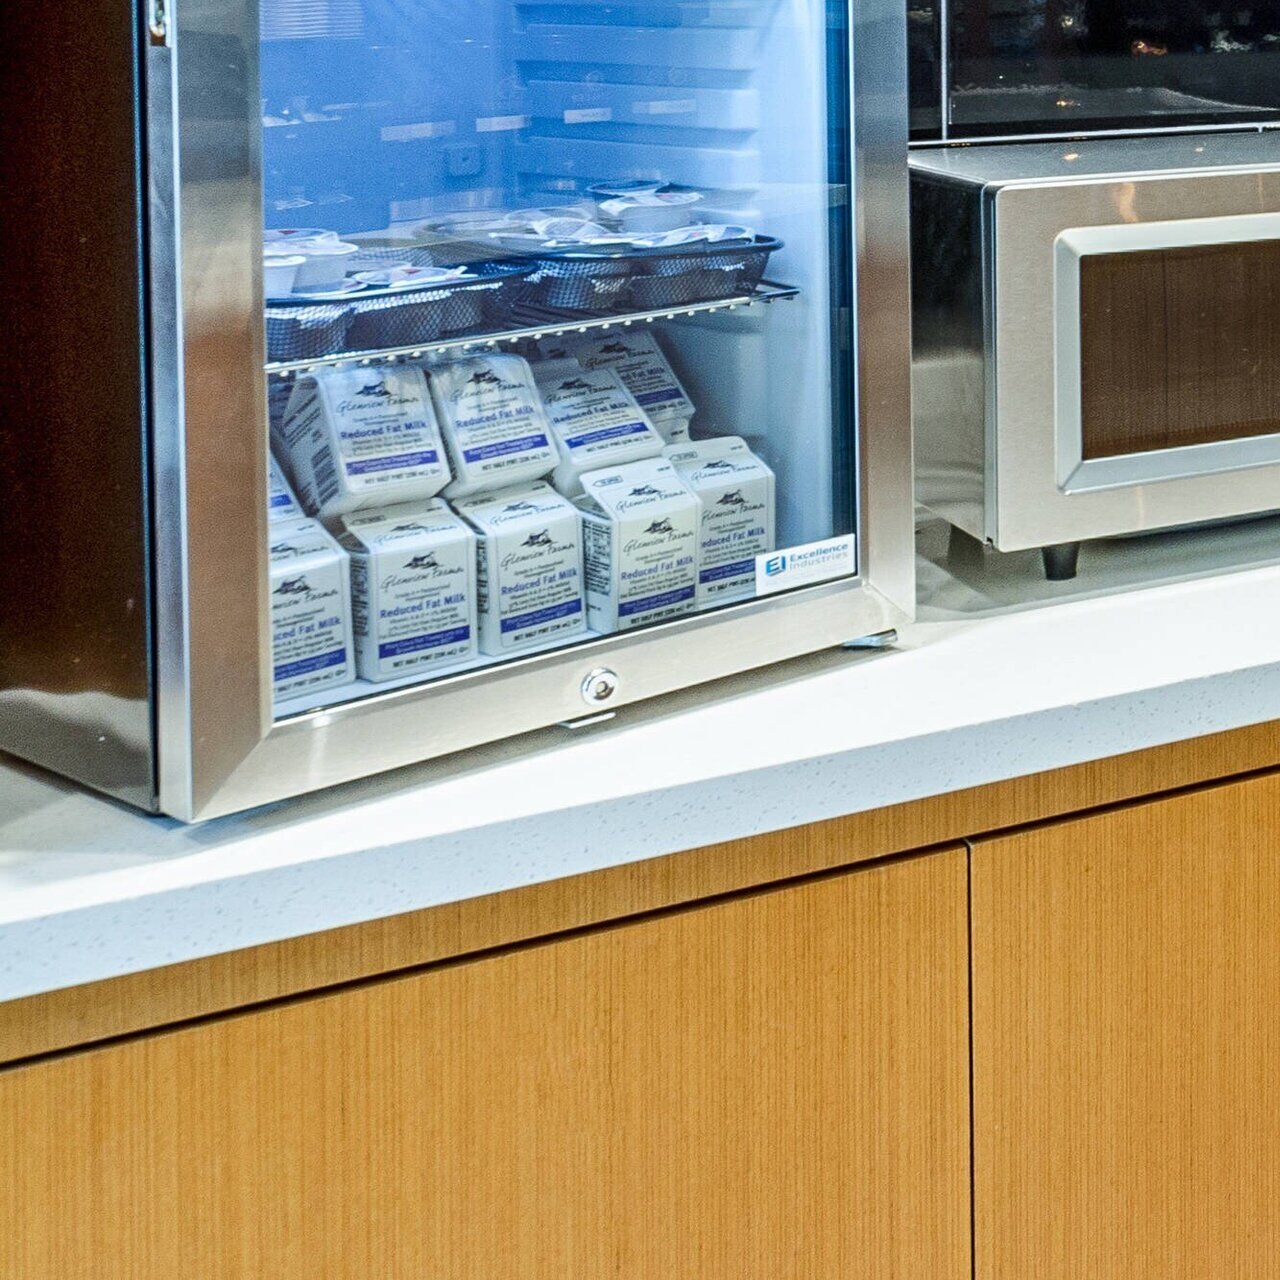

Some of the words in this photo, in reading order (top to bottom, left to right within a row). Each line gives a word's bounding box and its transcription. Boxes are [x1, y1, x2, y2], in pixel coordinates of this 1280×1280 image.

[702, 533, 731, 548] educed
[789, 543, 848, 562] Excellence
[789, 552, 849, 570] Industries
[621, 563, 658, 581] Reduced
[661, 561, 674, 571] Fat
[677, 555, 694, 567] Milk
[501, 578, 540, 595] Reduced
[543, 574, 557, 584] Fat
[559, 567, 577, 580] Milk
[380, 602, 423, 619] Reduced
[426, 599, 440, 608] Fat
[444, 592, 466, 605] Milk
[299, 622, 315, 635] Fat
[319, 616, 342, 631] Milk
